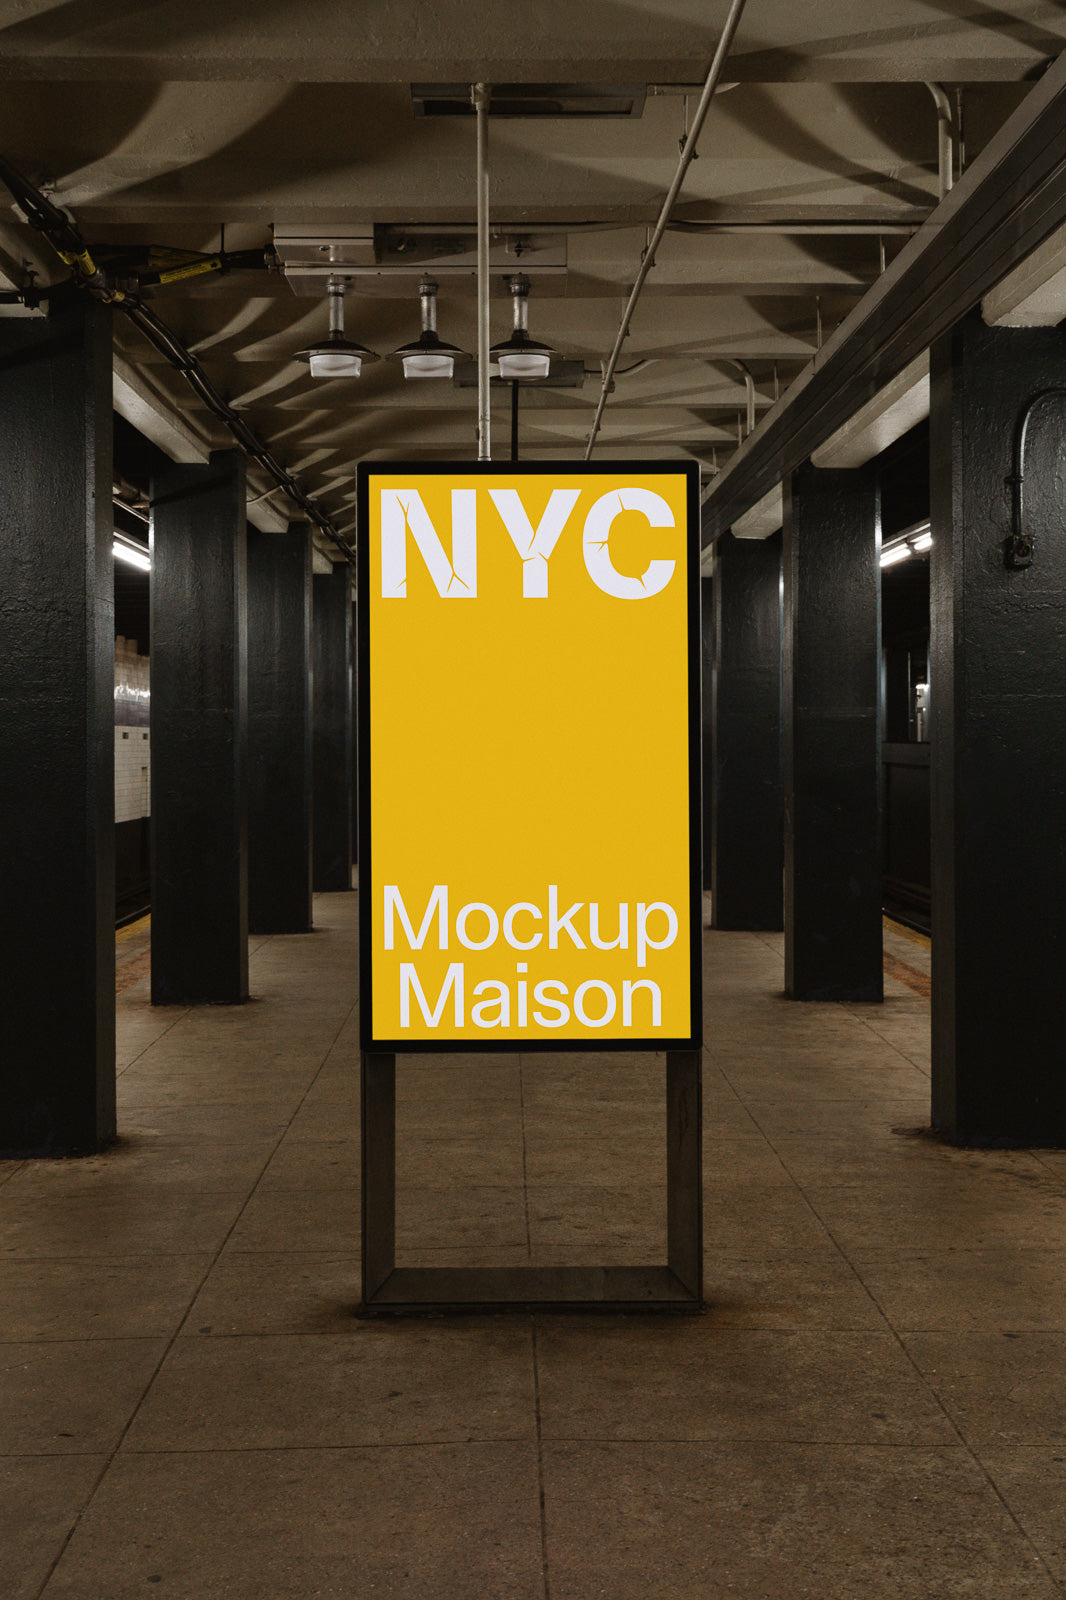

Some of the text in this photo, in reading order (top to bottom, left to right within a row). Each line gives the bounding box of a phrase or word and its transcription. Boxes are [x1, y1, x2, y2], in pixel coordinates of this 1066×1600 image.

[380, 488, 675, 599] NYC
[384, 885, 678, 967] Mockup
[400, 962, 662, 1028] Maison
